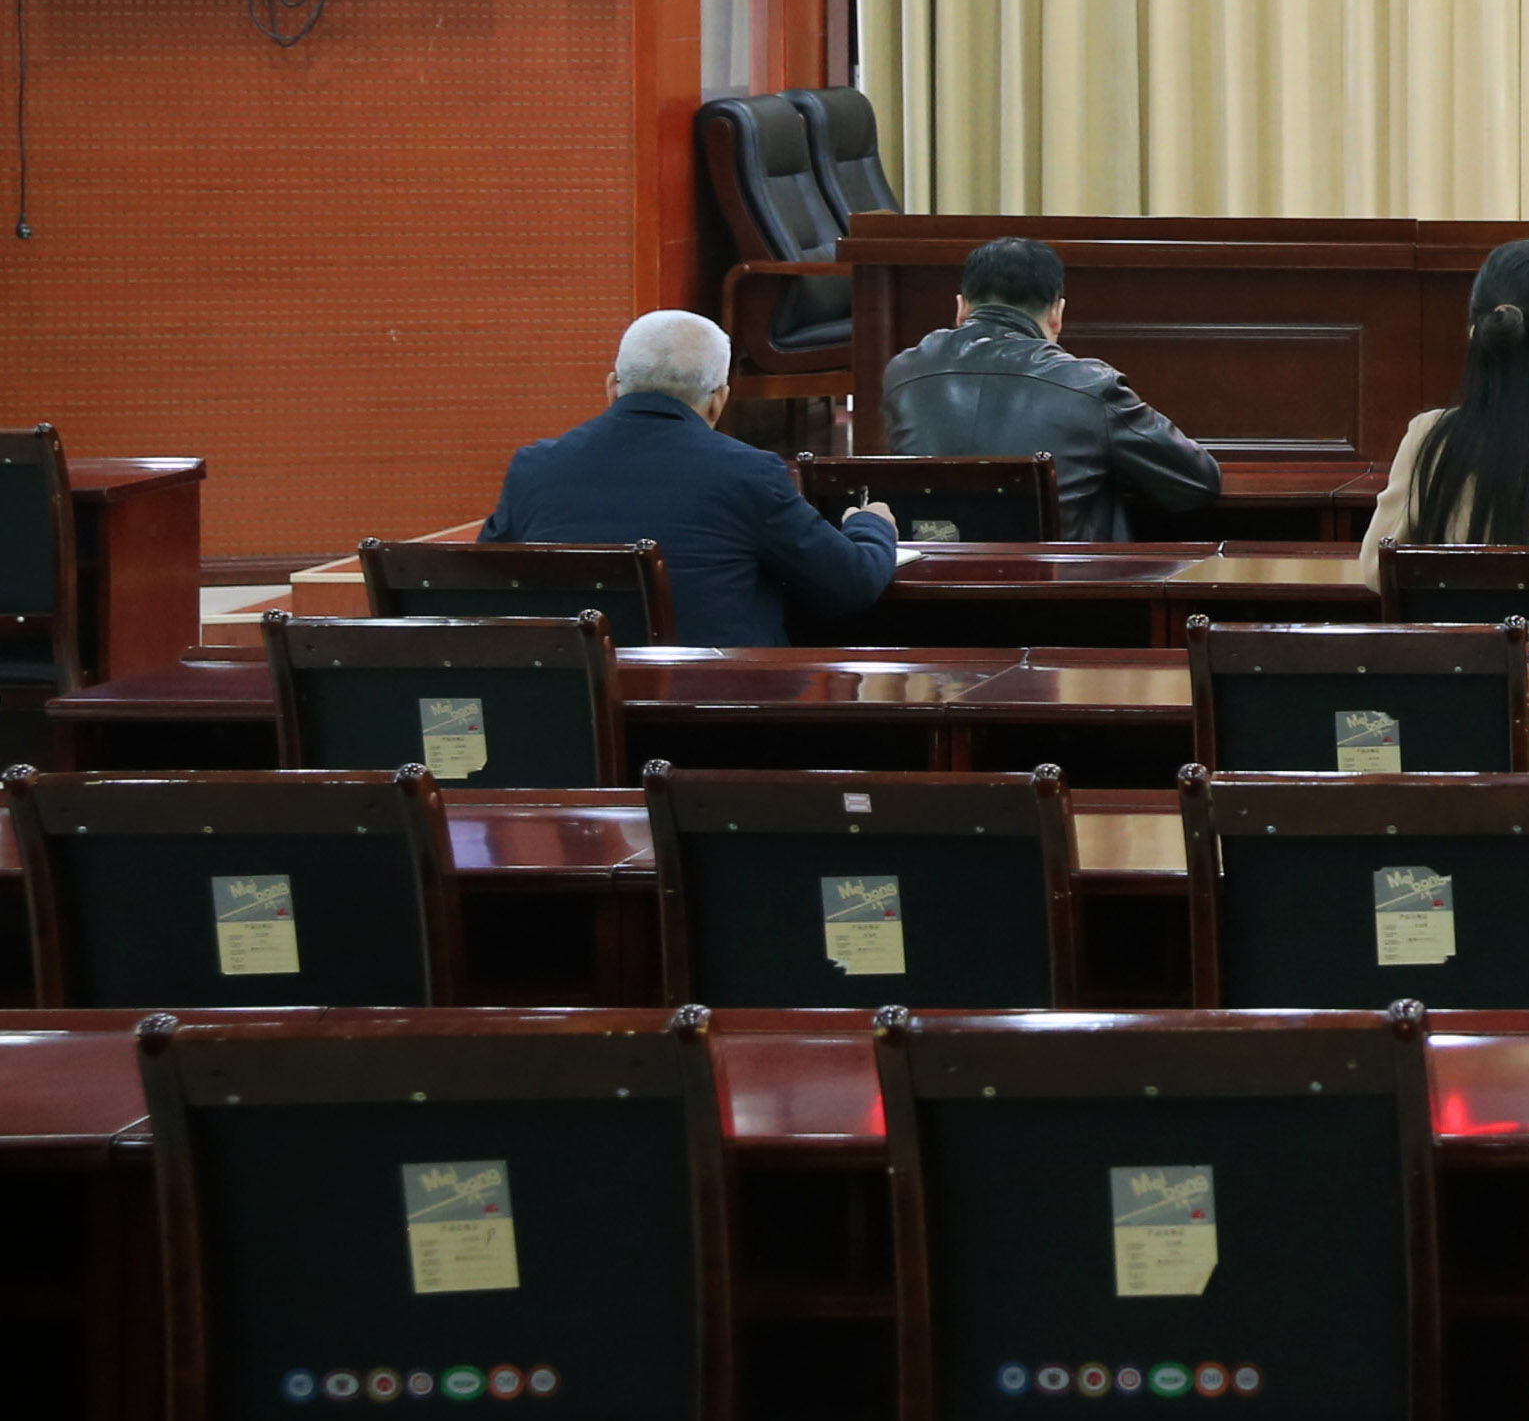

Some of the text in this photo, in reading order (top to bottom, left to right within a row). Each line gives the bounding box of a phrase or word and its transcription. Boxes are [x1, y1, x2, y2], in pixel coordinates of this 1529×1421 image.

[1386, 869, 1414, 888] Mei
[230, 879, 257, 898] Mei
[254, 882, 290, 900] bang
[837, 879, 865, 899] Mei
[862, 882, 897, 902] bang
